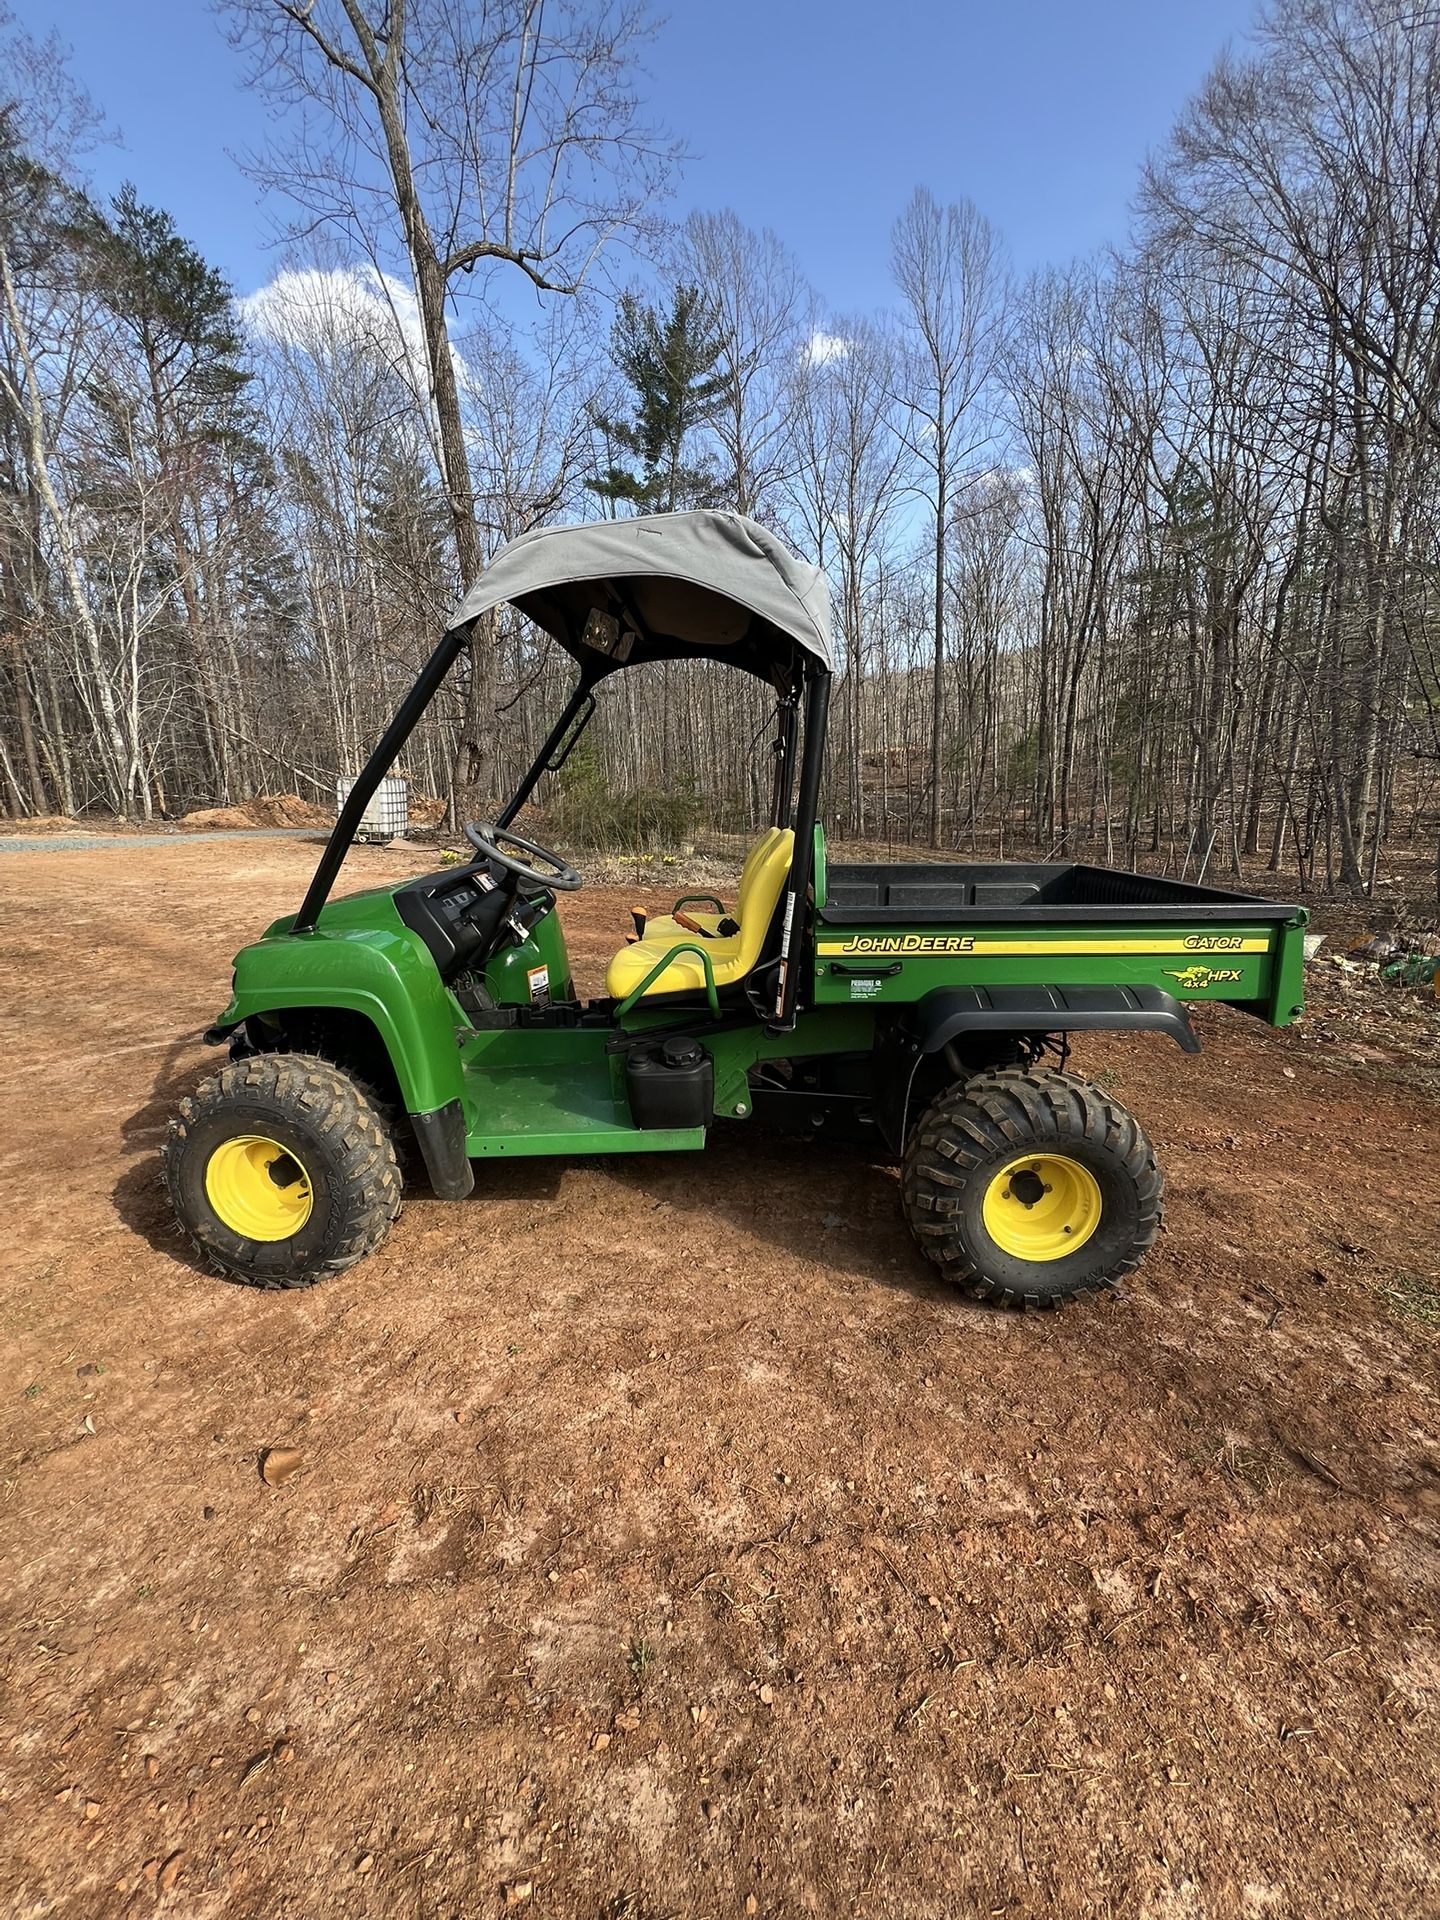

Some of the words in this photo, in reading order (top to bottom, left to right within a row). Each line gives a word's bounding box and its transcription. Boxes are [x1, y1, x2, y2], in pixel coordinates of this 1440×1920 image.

[843, 935, 900, 951] JOHN
[902, 934, 975, 951] DEERE
[1183, 935, 1243, 949] GATOR
[1207, 969, 1243, 982] HPX
